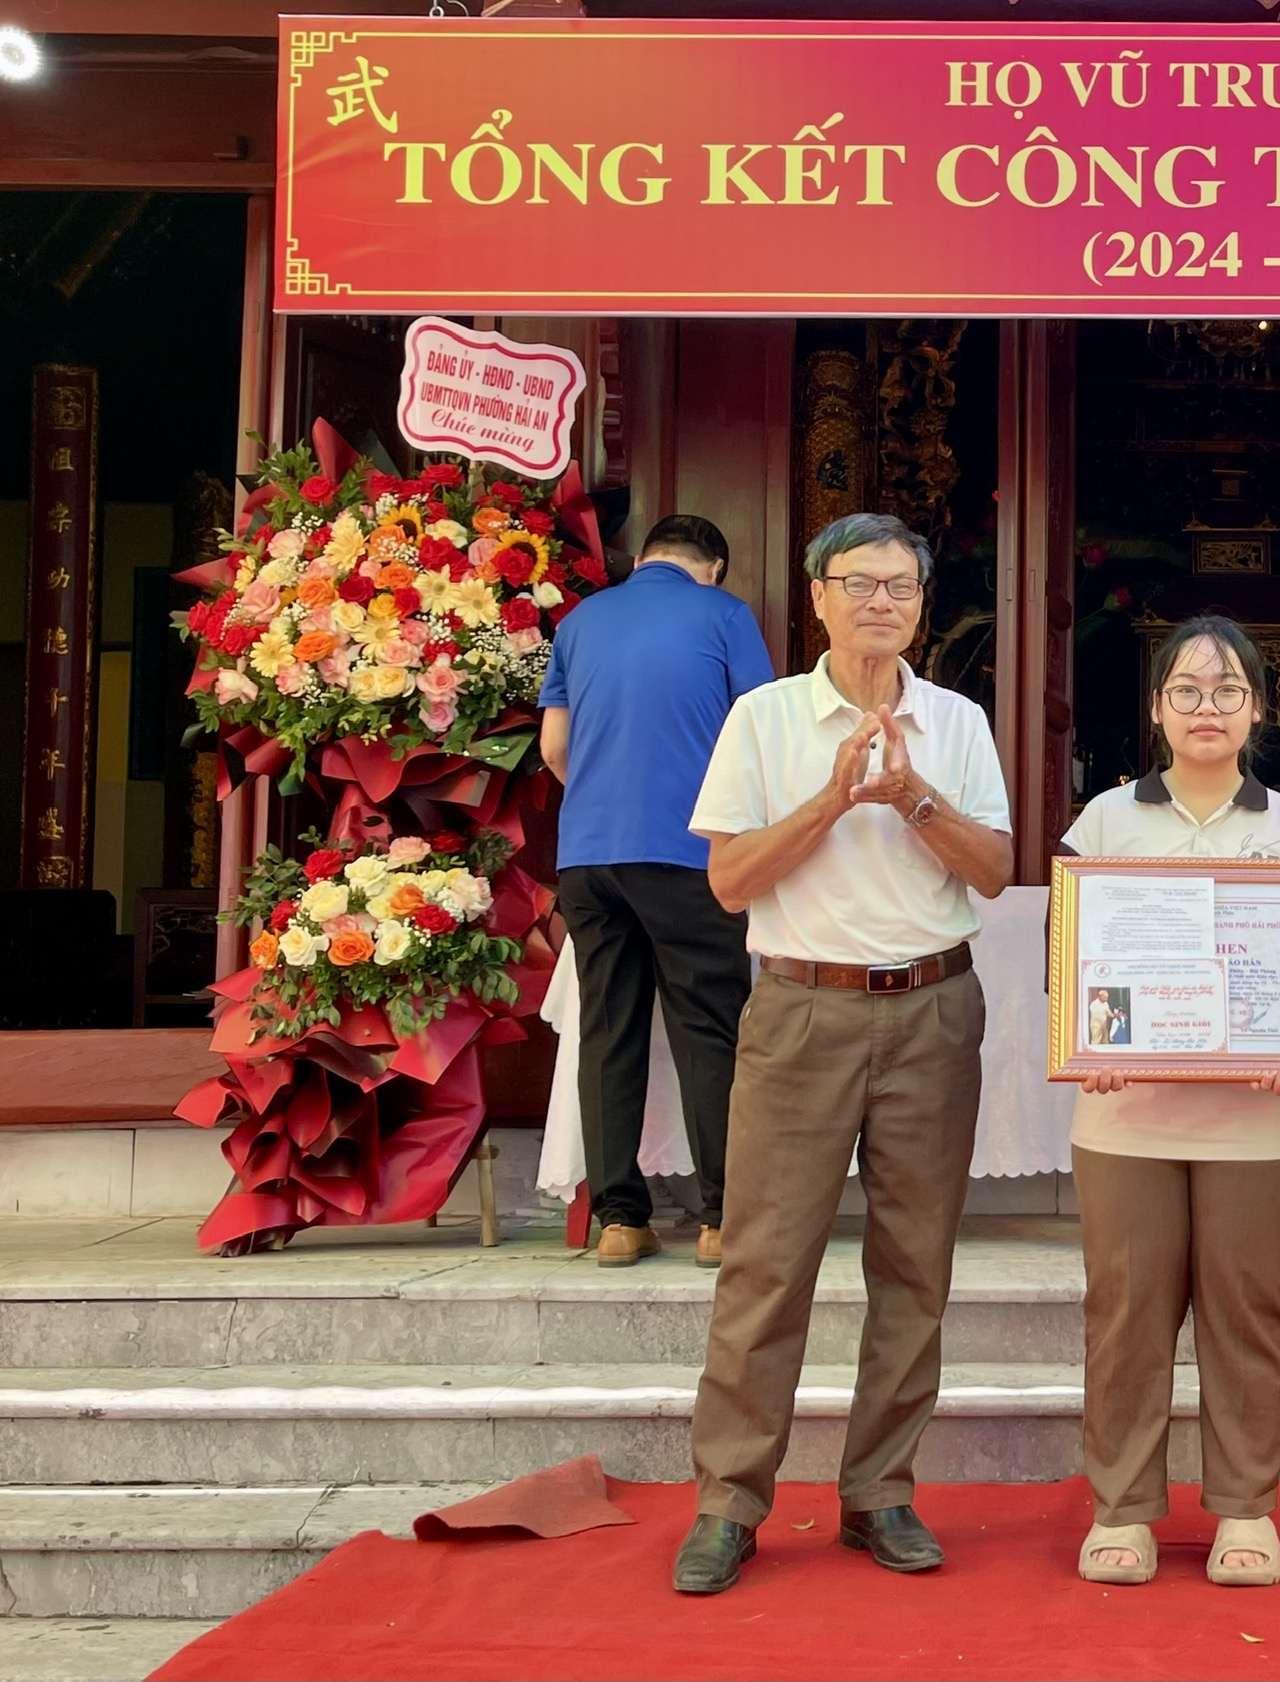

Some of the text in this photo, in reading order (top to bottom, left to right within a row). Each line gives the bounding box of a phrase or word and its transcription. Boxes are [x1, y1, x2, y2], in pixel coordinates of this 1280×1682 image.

[326, 56, 398, 133] 武
[945, 60, 1043, 120] HỌ
[1060, 50, 1151, 109] VŨ
[383, 109, 672, 206] TỔNG
[700, 112, 906, 206] KẾT
[936, 126, 1226, 208] CÔNG
[1082, 231, 1244, 287] (2024
[426, 343, 458, 377] ĐẢNG
[459, 350, 475, 381] ỦY
[482, 364, 514, 391] HĐND
[523, 374, 554, 400] UBND
[421, 382, 550, 432] UBMTTQVN PHƯỜNG HẢI AN
[431, 408, 535, 453] Chúc mừng
[1214, 921, 1234, 929] HÀNH
[1215, 943, 1248, 954] HEN
